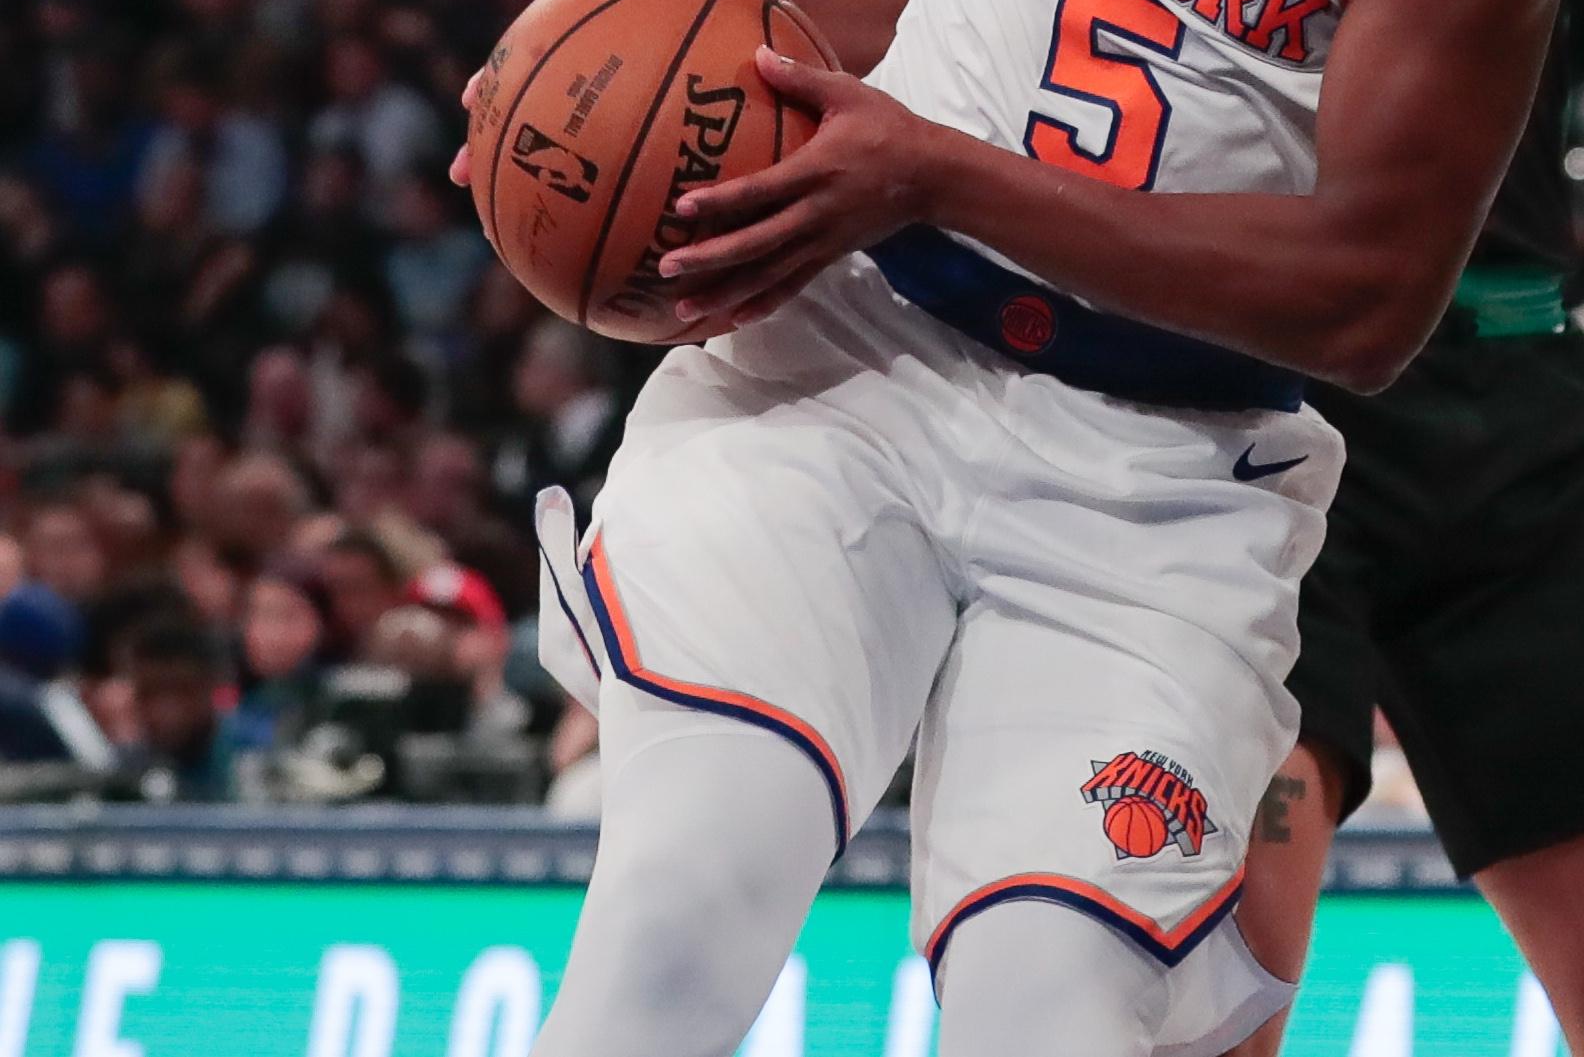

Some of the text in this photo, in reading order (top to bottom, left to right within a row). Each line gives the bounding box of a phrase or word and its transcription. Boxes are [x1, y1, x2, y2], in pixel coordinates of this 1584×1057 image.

[1080, 751, 1208, 856] KNICKS
[1140, 749, 1195, 788] NEW YORK
